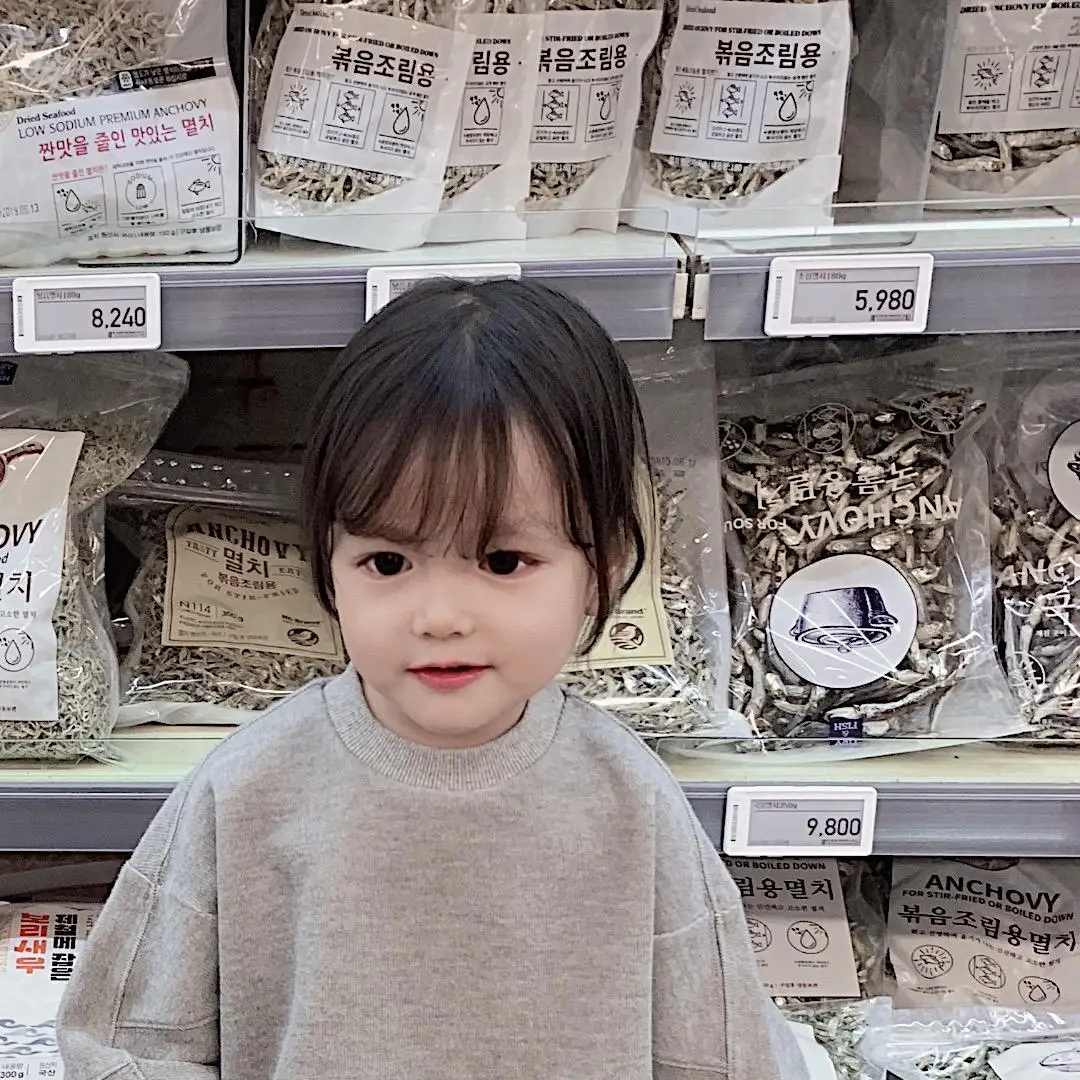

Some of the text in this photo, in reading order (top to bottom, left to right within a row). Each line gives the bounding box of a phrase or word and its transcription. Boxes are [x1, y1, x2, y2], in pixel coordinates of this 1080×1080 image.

[332, 45, 436, 88] 볶음조림용
[715, 40, 821, 69] 볶음조림용
[16, 107, 76, 125] Dried Seafood
[18, 125, 45, 139] LOW
[49, 117, 96, 134] SODIUM
[99, 109, 150, 126] PREMIUM
[153, 98, 209, 118] ANCHOVY
[39, 136, 89, 162] 짠맛을
[94, 128, 126, 152] 줄인
[131, 124, 177, 147] 맛있는
[182, 113, 216, 137] 멸치
[724, 494, 963, 541] ANCHOVY FOR SOU
[223, 547, 269, 578] 멸치
[834, 721, 858, 732] FISH
[735, 861, 826, 870] OR BOILED DOWN
[732, 876, 834, 901] 림용멸치
[925, 874, 1061, 913] ANCHOVY
[902, 889, 924, 897] FOR
[926, 891, 986, 905] STIR-FRIED
[988, 900, 1003, 909] OR
[1005, 905, 1041, 922] BOILED
[897, 904, 1077, 955] 볶음조림용멸치
[0, 1071, 17, 1079] 300
